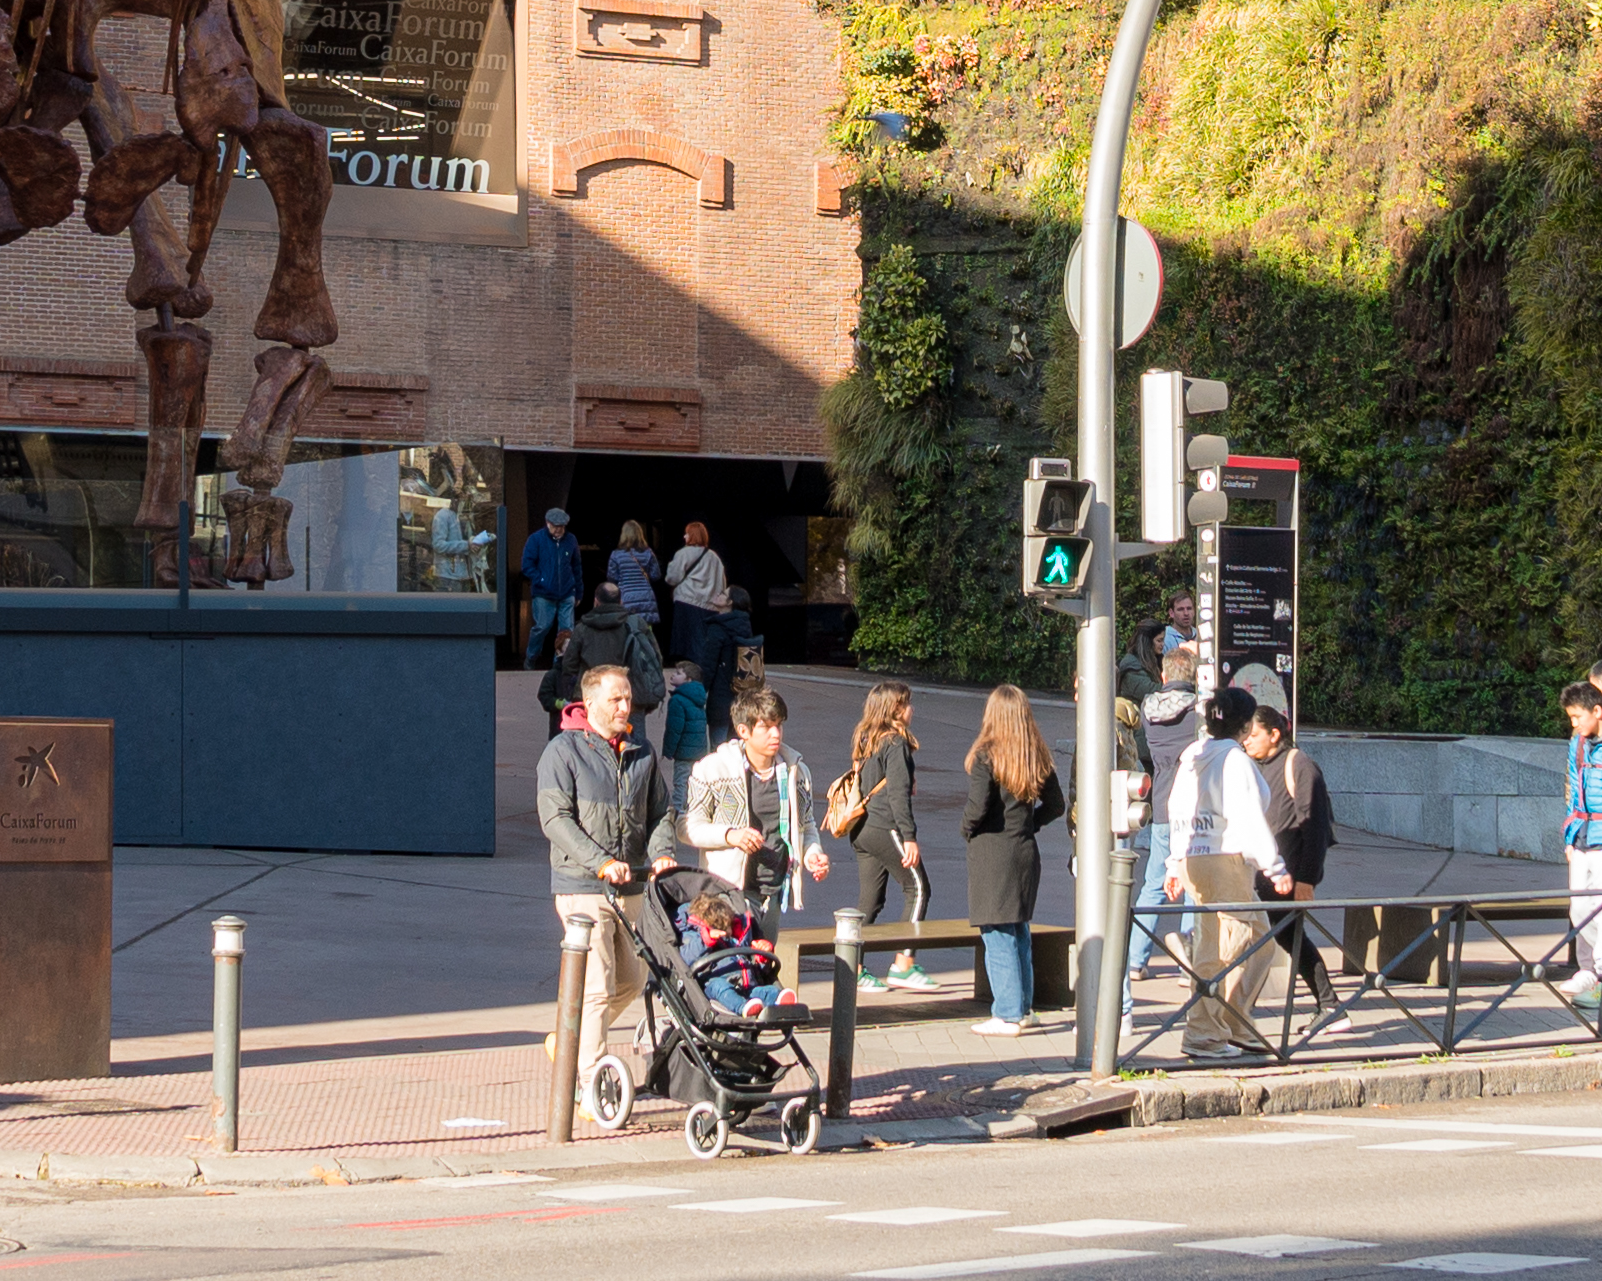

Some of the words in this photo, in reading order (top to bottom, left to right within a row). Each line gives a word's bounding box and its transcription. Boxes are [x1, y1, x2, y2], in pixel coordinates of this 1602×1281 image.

[283, 38, 357, 56] CaixaForum
[360, 34, 508, 71] CaixaForum
[380, 65, 490, 94] CaixaForum
[428, 93, 500, 111] CaixaForum
[361, 105, 493, 138] CaixaForum
[0, 812, 77, 829] CaixaForum
